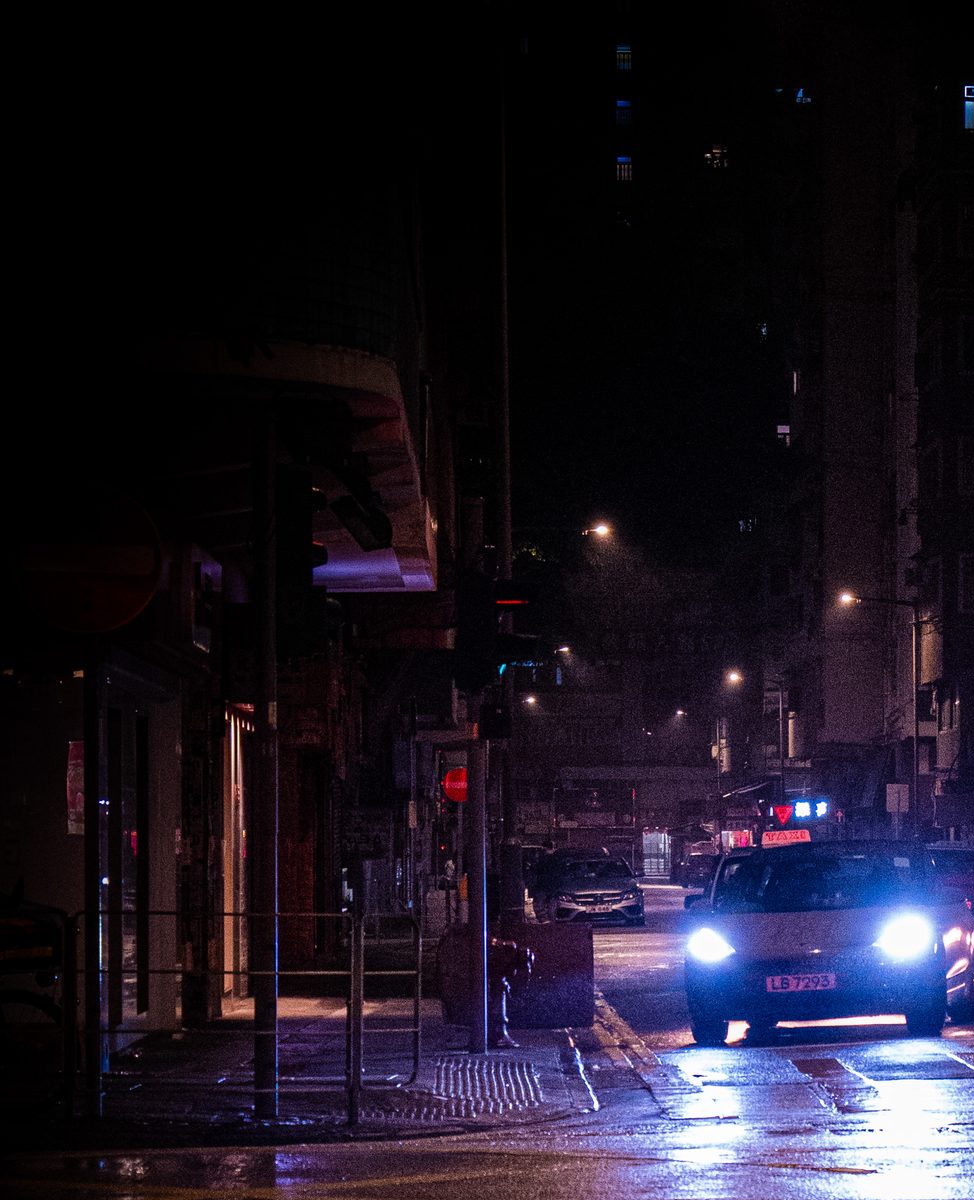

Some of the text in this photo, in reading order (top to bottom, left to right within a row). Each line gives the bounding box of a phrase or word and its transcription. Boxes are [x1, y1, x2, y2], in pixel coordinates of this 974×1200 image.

[765, 830, 806, 842] TAXI
[771, 974, 830, 990] LB 7293
